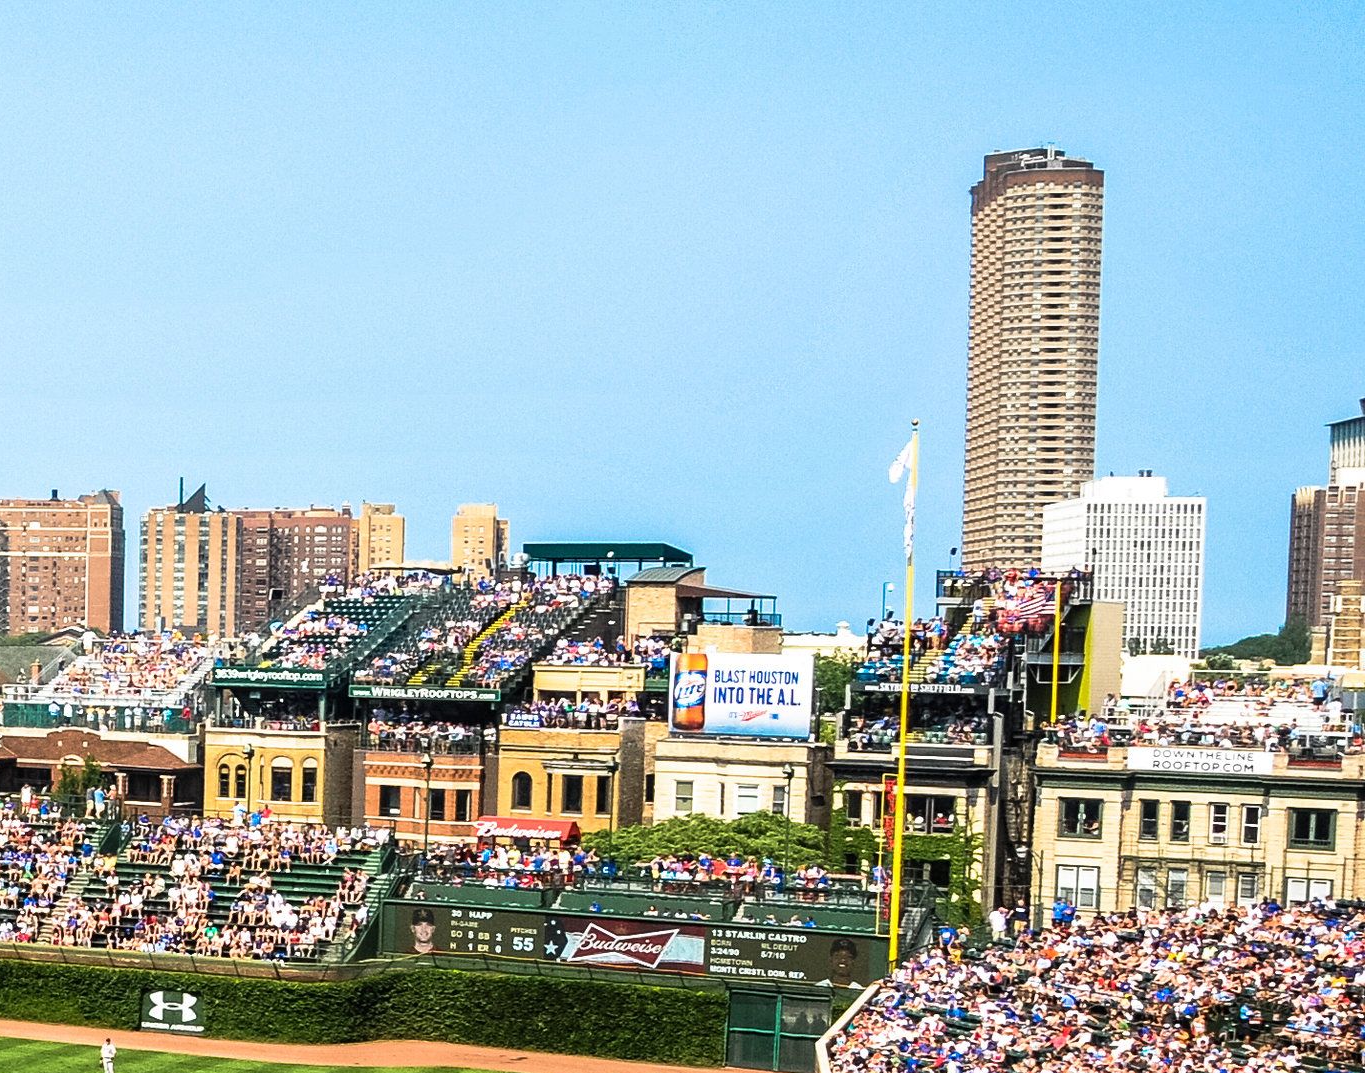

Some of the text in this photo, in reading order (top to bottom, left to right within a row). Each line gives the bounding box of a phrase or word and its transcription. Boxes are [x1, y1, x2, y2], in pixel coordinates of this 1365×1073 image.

[714, 669, 799, 685] BLAST HOUSTON
[713, 687, 801, 706] INTO THE A.L.
[473, 821, 562, 839] Budweiser
[468, 910, 493, 920] HAPP
[510, 927, 538, 935] PITCHES
[711, 929, 807, 943] 13 STARLIN CASTRO
[467, 943, 473, 951] 1
[512, 936, 534, 951] 55
[578, 933, 667, 955] Budweiser
[773, 943, 799, 951] DEBUT
[709, 957, 753, 966] HOMETOWN
[709, 965, 737, 974] MONTE
